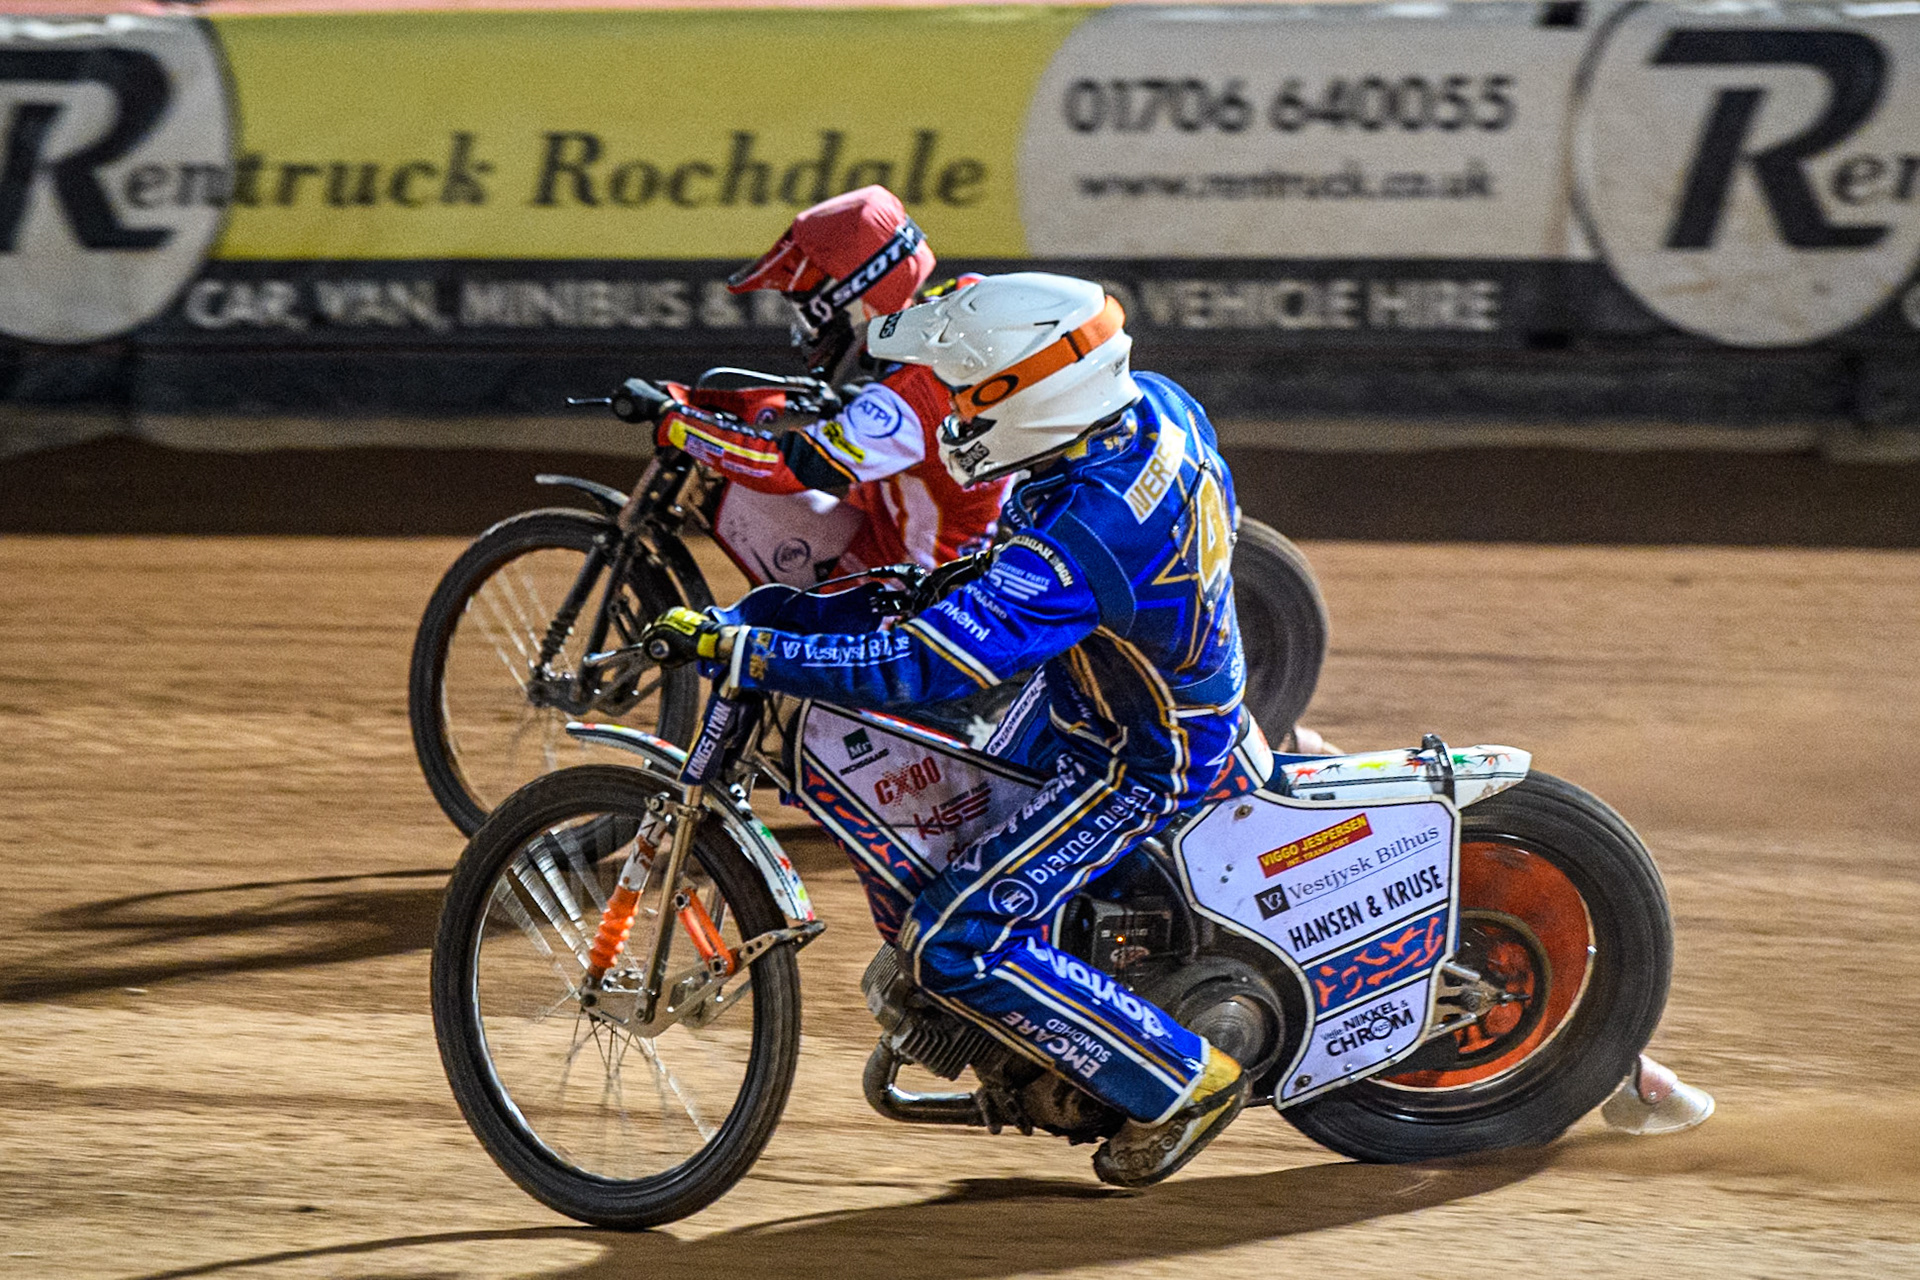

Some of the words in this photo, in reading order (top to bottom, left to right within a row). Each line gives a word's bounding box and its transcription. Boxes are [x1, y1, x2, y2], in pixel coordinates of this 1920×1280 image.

[1064, 77, 1253, 134] 01706
[1268, 74, 1516, 134] 640055
[532, 130, 989, 208] Rochdale
[1145, 279, 1361, 330] VEHICLE
[1369, 280, 1500, 331] HIRE
[858, 400, 893, 428] ATPI
[686, 735, 717, 780] KINGS
[705, 700, 732, 741] LYNN
[873, 755, 942, 807] CX80
[1025, 829, 1096, 885] bjarne
[1260, 844, 1298, 868] VIGGO
[1301, 815, 1368, 850] JESPERSEN
[1288, 856, 1374, 901] Vestjysk
[1376, 826, 1440, 865] Bilhus
[1303, 837, 1350, 861] TRANSPORT
[1287, 901, 1365, 953] HANSEN
[1367, 895, 1383, 919] &
[1382, 864, 1444, 911] KRUSE
[1046, 1017, 1112, 1064] SUNDHED
[1325, 1008, 1415, 1057] CHROM
[1342, 1001, 1399, 1032] NIKKEL
[1003, 1010, 1102, 1080] EMCARE
